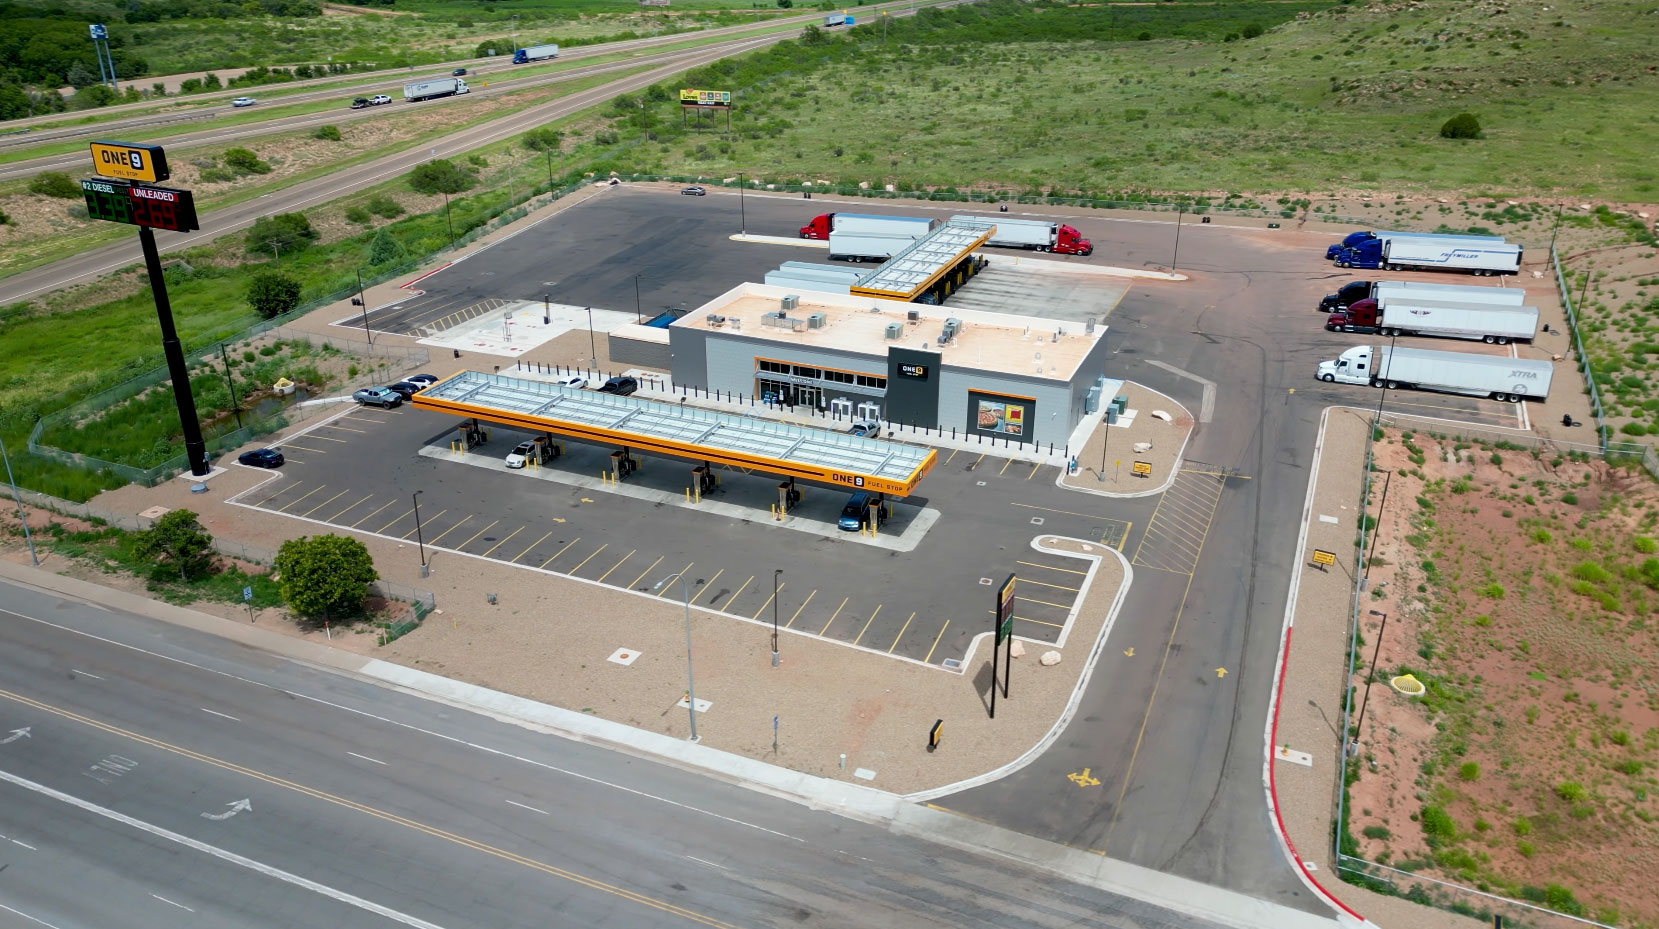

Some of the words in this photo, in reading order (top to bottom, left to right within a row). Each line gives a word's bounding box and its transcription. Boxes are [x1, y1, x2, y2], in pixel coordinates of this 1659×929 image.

[82, 181, 91, 190] #2
[92, 182, 115, 194] DIESEL
[133, 188, 174, 202] UNLEADED
[1507, 370, 1537, 379] XTRA
[868, 481, 883, 489] FUEL
[886, 484, 903, 492] STOP
